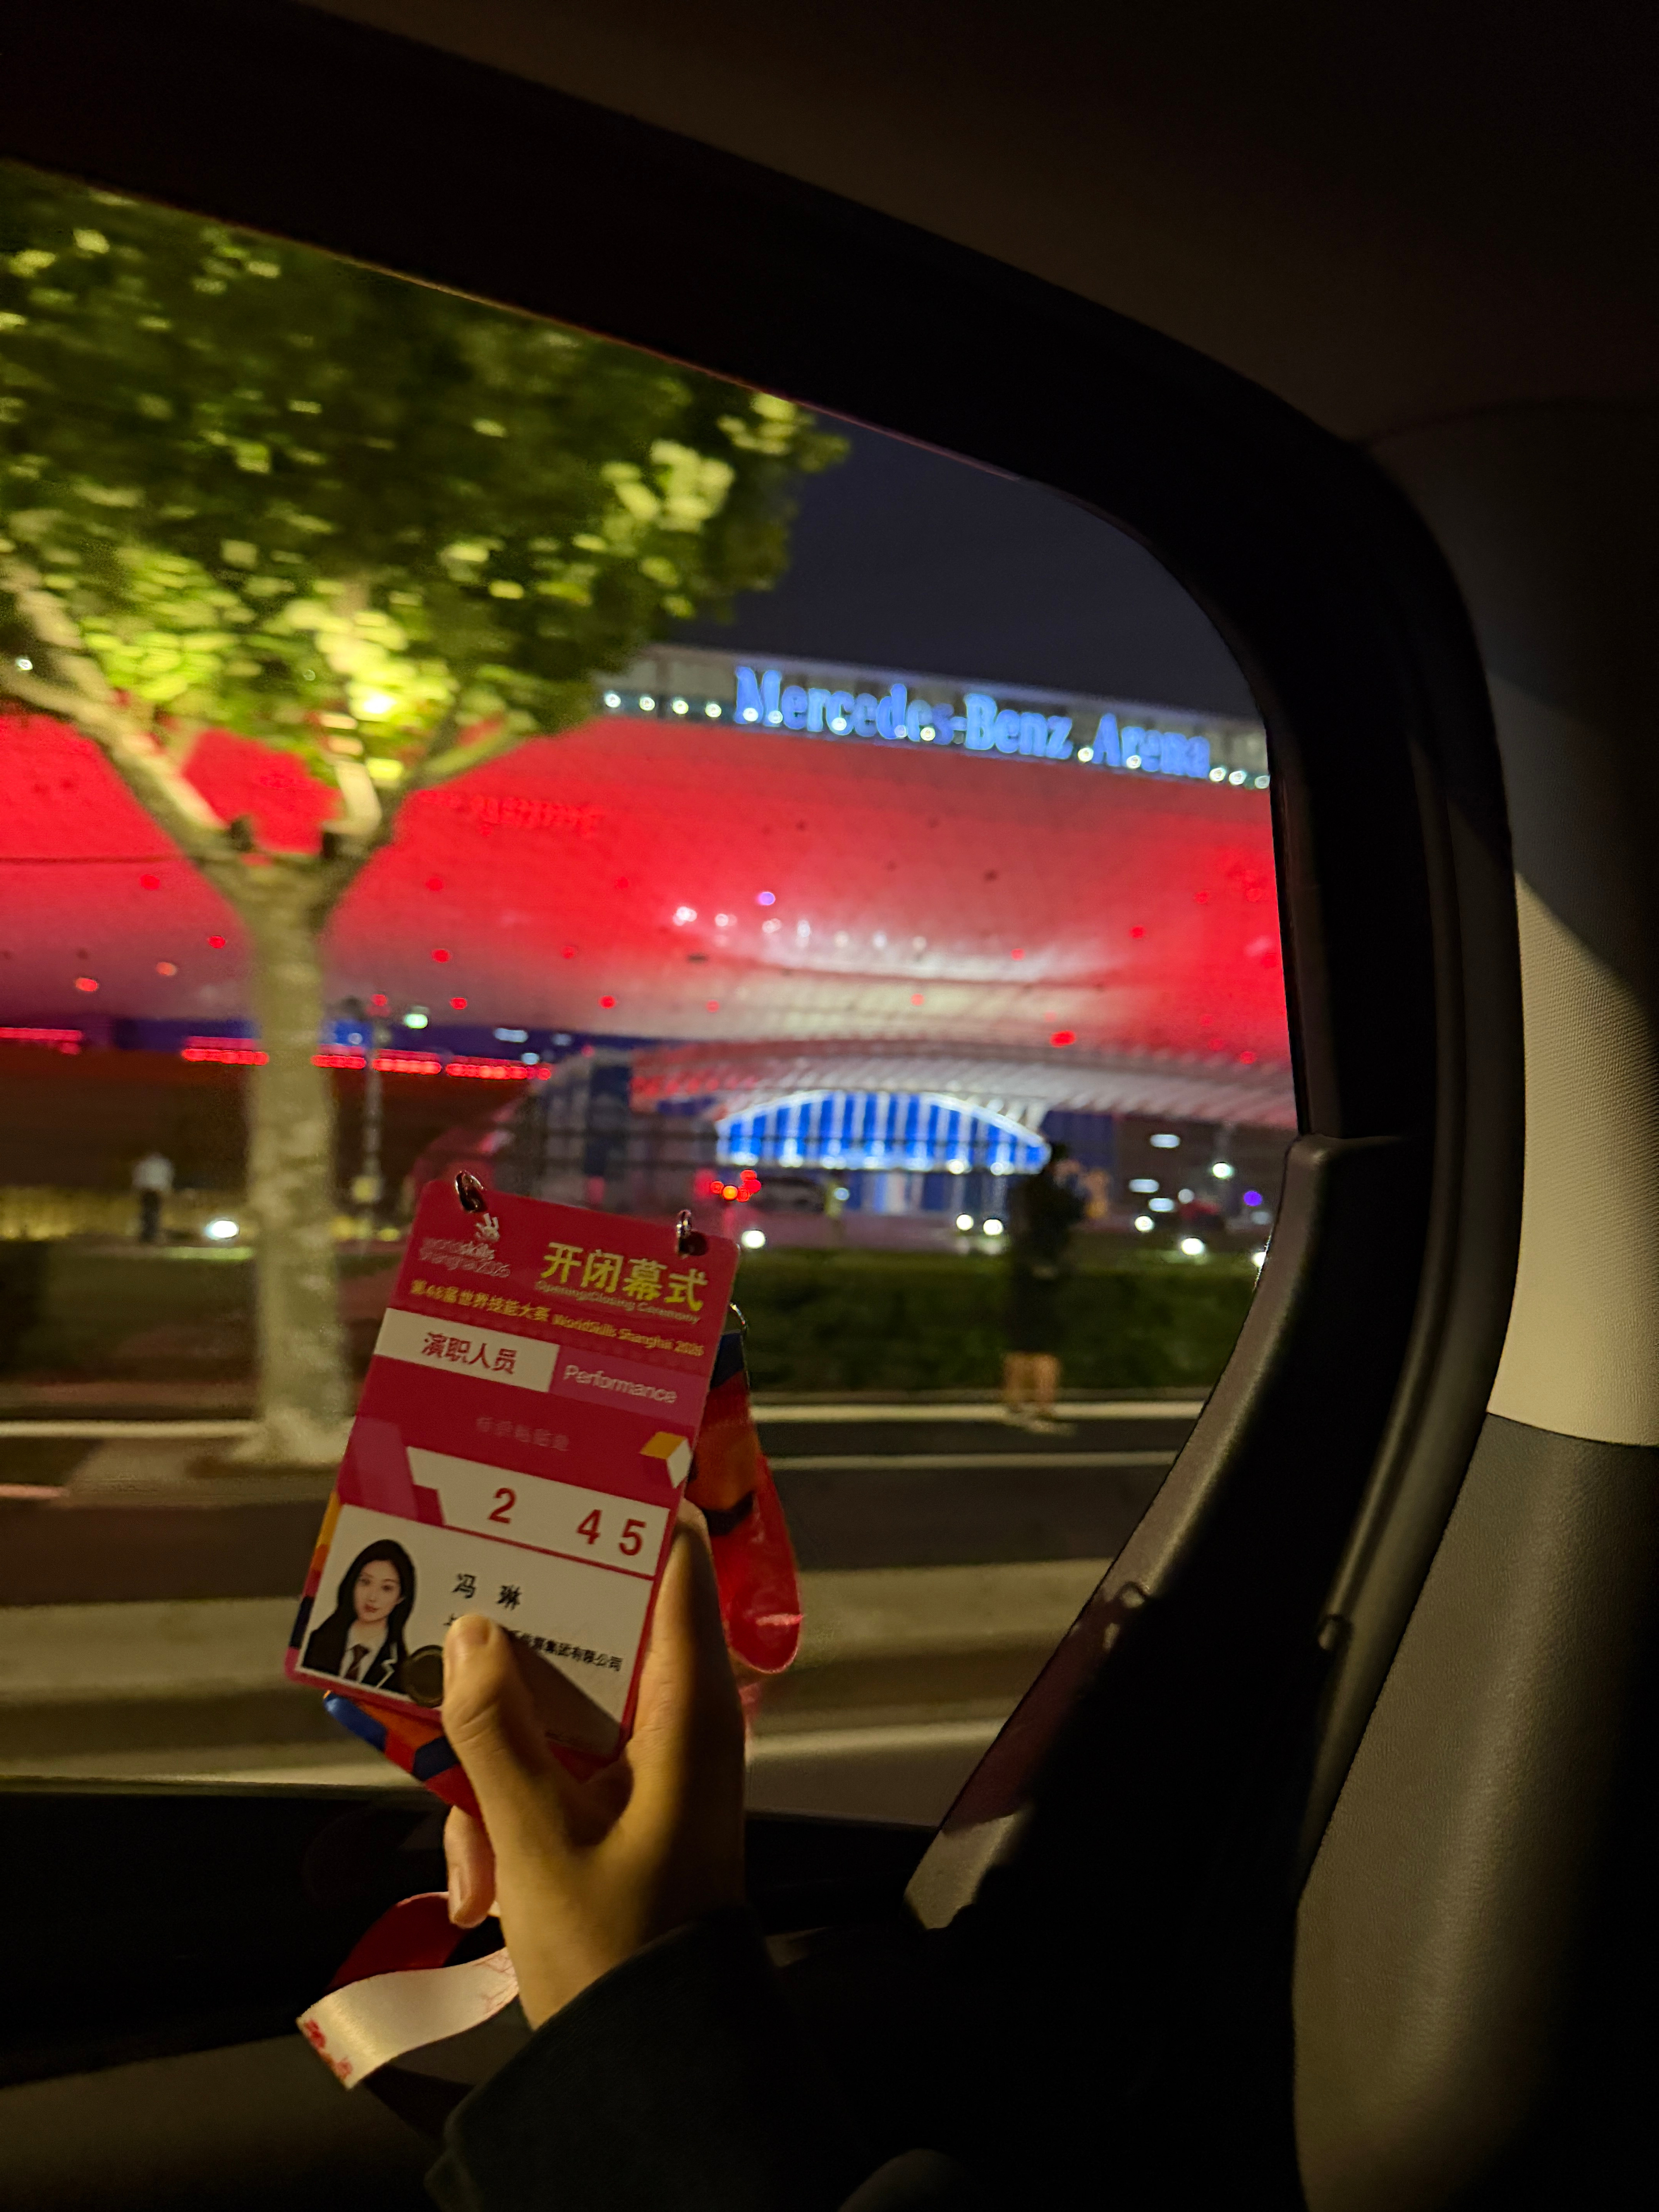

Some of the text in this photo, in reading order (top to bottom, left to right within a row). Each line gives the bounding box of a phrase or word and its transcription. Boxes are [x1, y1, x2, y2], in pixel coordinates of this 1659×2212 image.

[734, 666, 1210, 778] Mercedes-Benz Arena
[541, 1242, 708, 1311] 开闭幕式
[421, 1331, 518, 1375] 演职人员
[618, 1328, 673, 1350] Shanghai
[673, 1340, 704, 1357] 2026
[563, 1364, 677, 1404] Performance
[487, 1487, 517, 1524] 2
